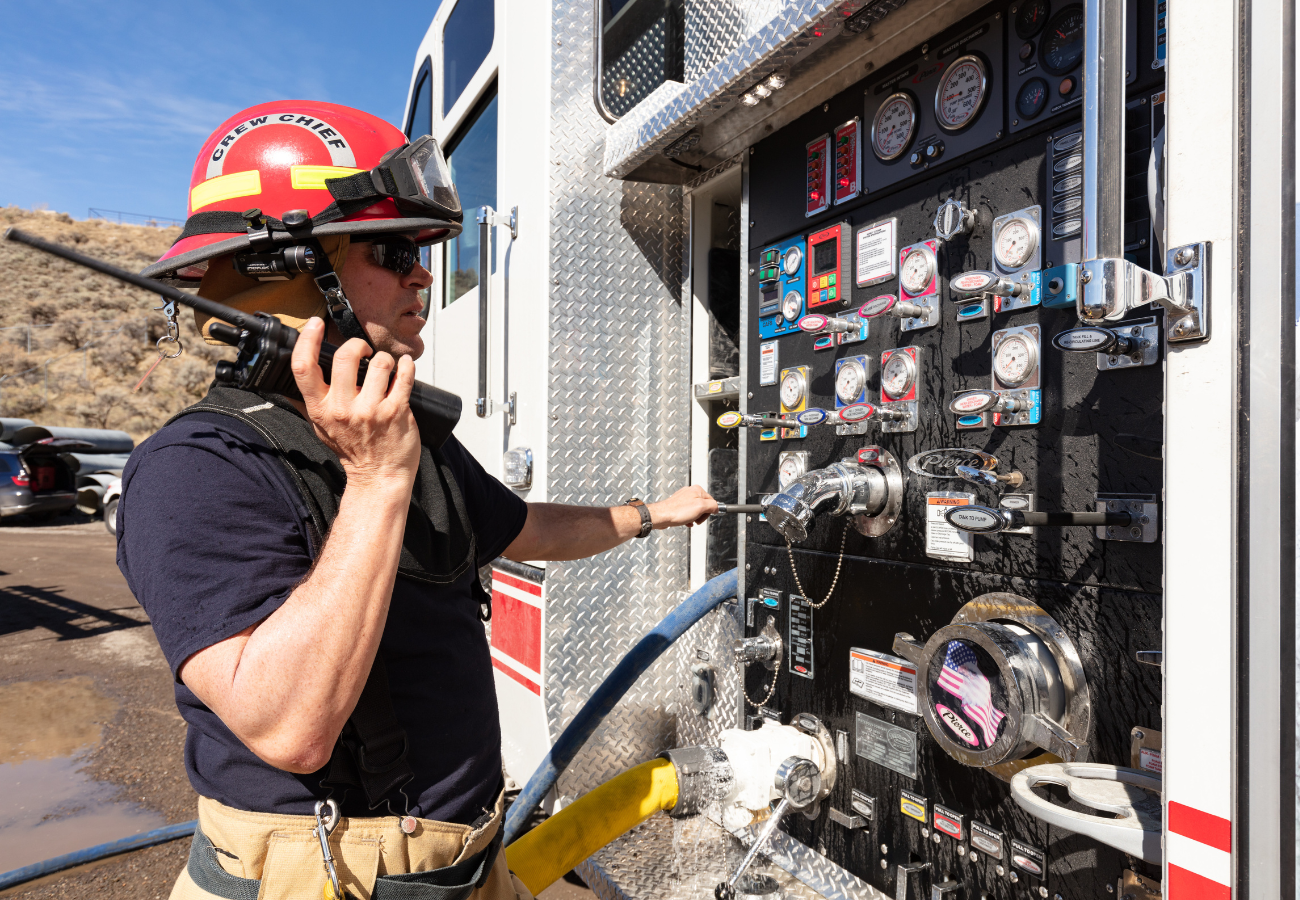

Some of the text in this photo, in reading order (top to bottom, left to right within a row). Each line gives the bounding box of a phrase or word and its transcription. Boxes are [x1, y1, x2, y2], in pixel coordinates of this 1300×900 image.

[942, 42, 960, 54] MASTER
[958, 71, 967, 80] 300
[965, 74, 974, 83] 400
[950, 80, 959, 90] 200
[967, 84, 976, 94] 500
[962, 99, 972, 108] 600
[884, 114, 893, 123] 200
[898, 110, 906, 118] 400
[212, 114, 346, 161] CREW CHIEF
[849, 180, 856, 193] B
[818, 195, 825, 207] A
[922, 454, 980, 470] Pierce
[942, 710, 971, 739] Pierce
[988, 830, 1000, 840] OPEN
[1012, 842, 1023, 851] PULL
[1030, 850, 1042, 860] OPEN
